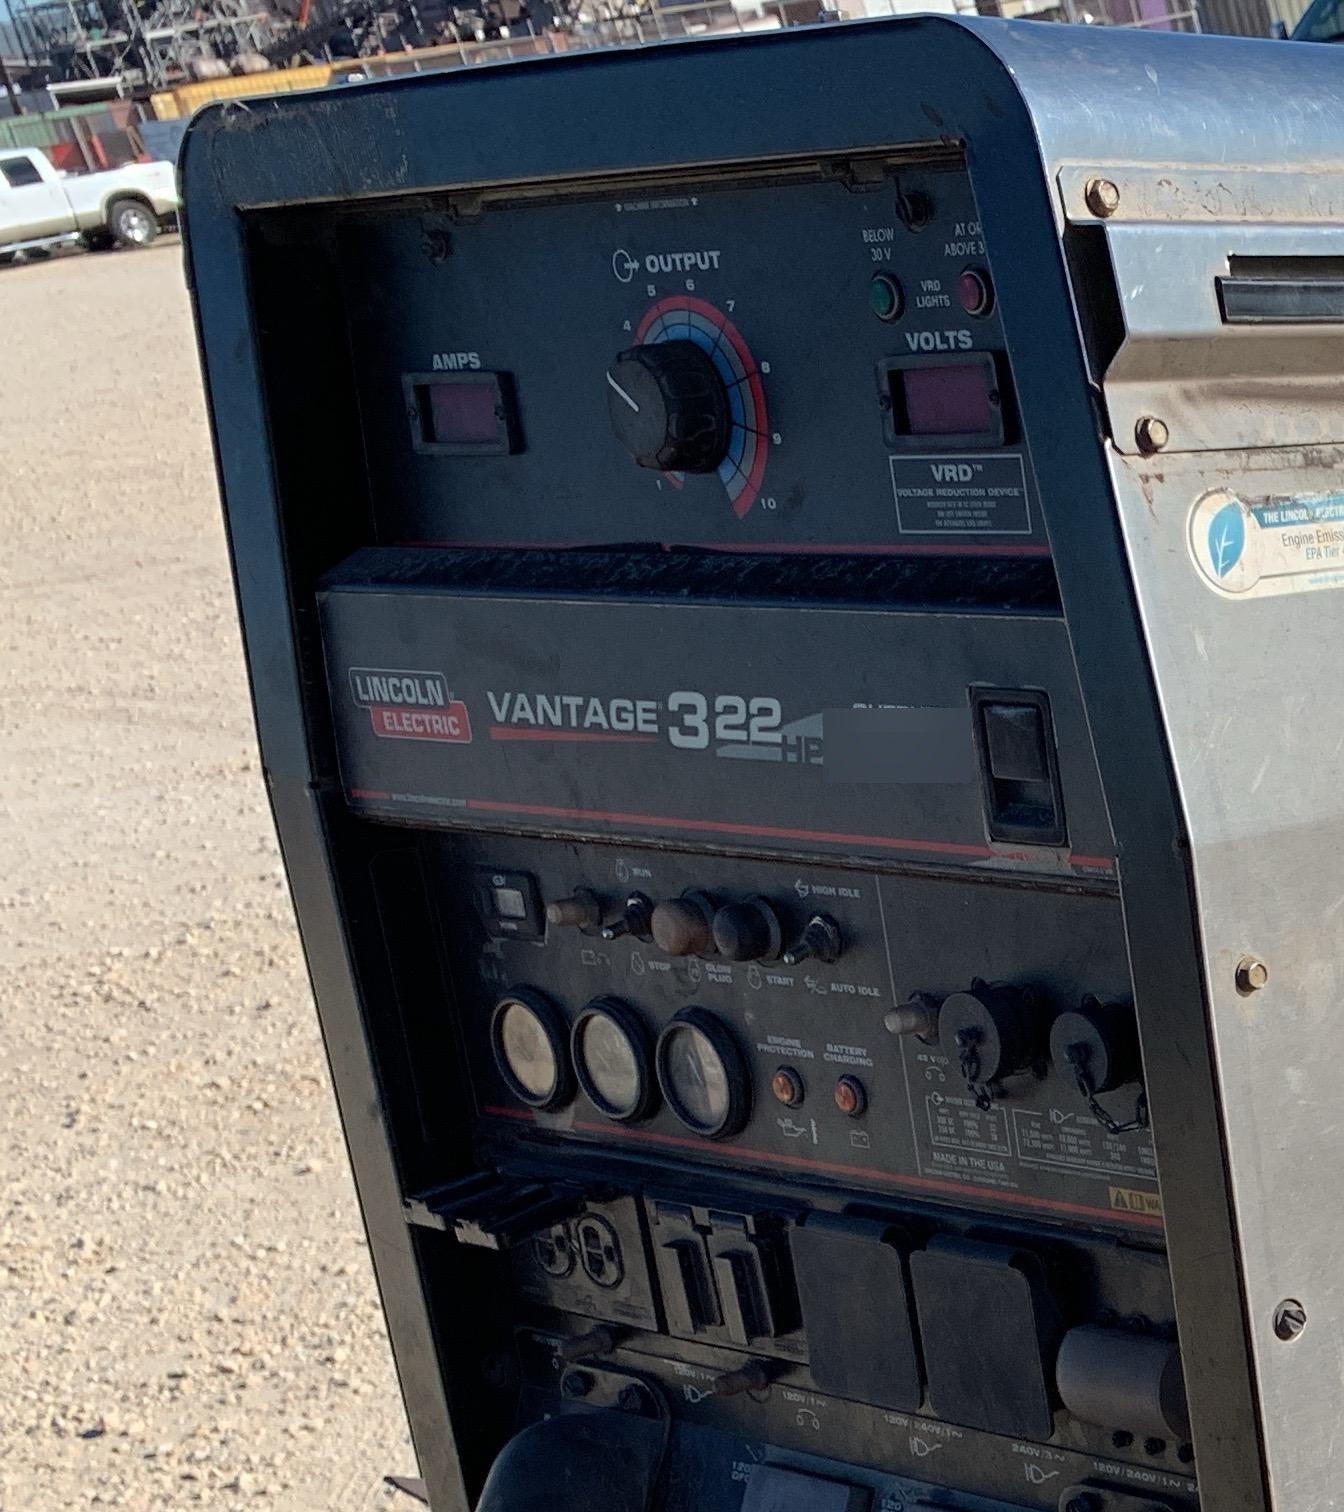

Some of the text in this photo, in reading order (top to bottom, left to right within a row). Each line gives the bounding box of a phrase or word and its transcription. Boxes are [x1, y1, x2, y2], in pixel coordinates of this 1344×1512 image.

[861, 227, 895, 243] BELOW
[645, 249, 721, 274] OUTPUT
[647, 284, 657, 297] 5
[686, 278, 696, 291] 6
[920, 279, 941, 292] VRD
[727, 299, 736, 312] 7
[915, 295, 951, 309] LIGHTS
[622, 320, 632, 332] 4
[905, 330, 974, 351] VOLTS
[431, 351, 482, 371] AMPS
[761, 361, 771, 373] 8
[772, 433, 782, 446] 9
[656, 479, 664, 491] 1
[760, 497, 777, 511] 10
[1281, 530, 1315, 549] Engine
[1305, 547, 1323, 560] EPA
[354, 674, 783, 751] LINCOLN VANTAGE 322
[382, 711, 460, 738] ELECTRIC
[812, 884, 861, 899] HIGH IDLE
[765, 974, 795, 988] START
[830, 982, 881, 998] AUTO IDLE
[825, 1042, 869, 1058] BATTERY
[933, 1151, 958, 1164] MADE
[959, 1155, 968, 1166] IN
[969, 1157, 986, 1169] THE
